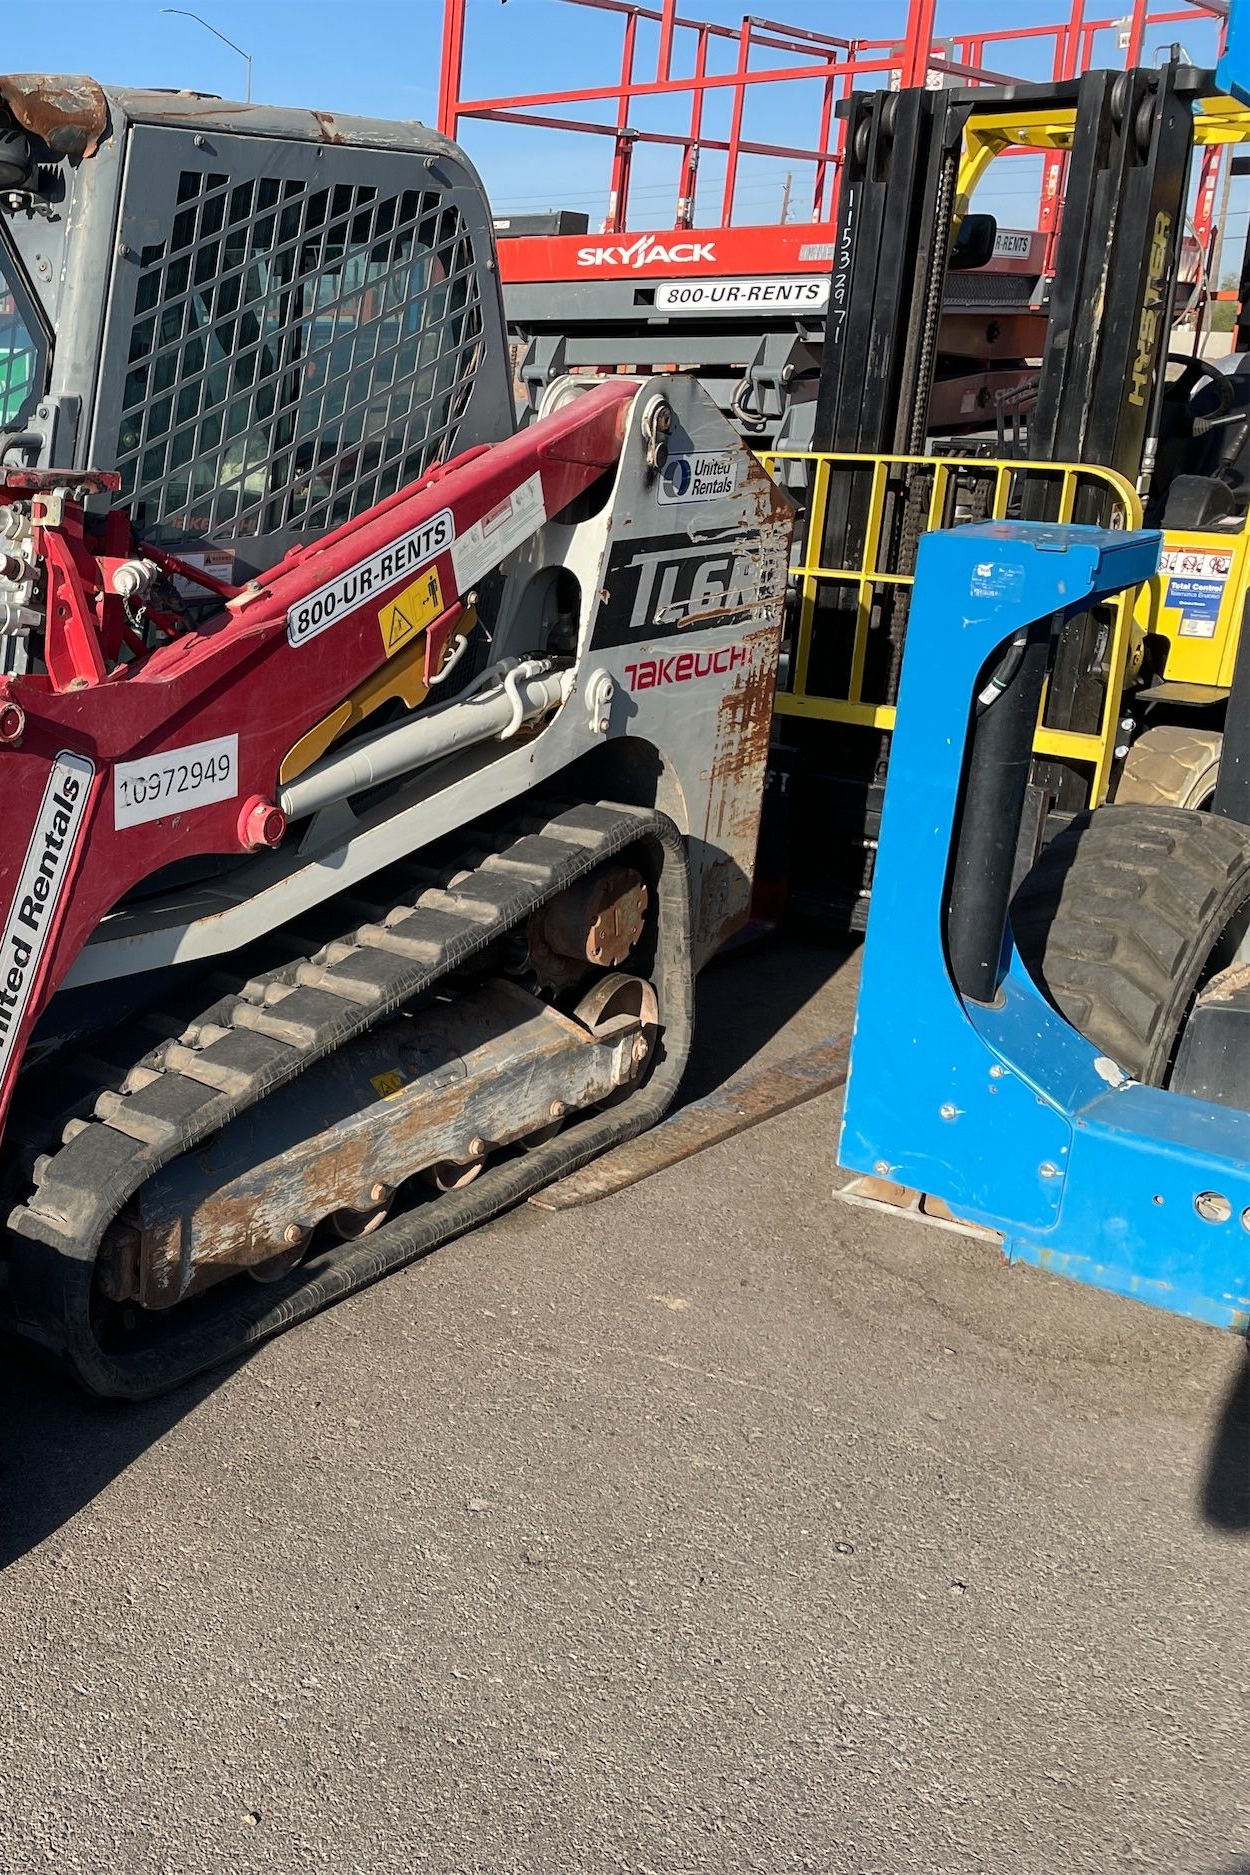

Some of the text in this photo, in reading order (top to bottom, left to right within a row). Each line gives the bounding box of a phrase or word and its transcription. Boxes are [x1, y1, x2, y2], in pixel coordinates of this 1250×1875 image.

[577, 234, 717, 269] SKYJACK
[995, 235, 1029, 252] R-RENTS
[667, 283, 820, 304] 800-UR-RENTS
[694, 458, 731, 476] United
[692, 477, 732, 496] Rentals
[298, 520, 446, 634] 800-UR-RENTS
[1171, 582, 1223, 592] Total Control
[120, 754, 230, 807] 10972949
[18, 774, 81, 932] Rentals
